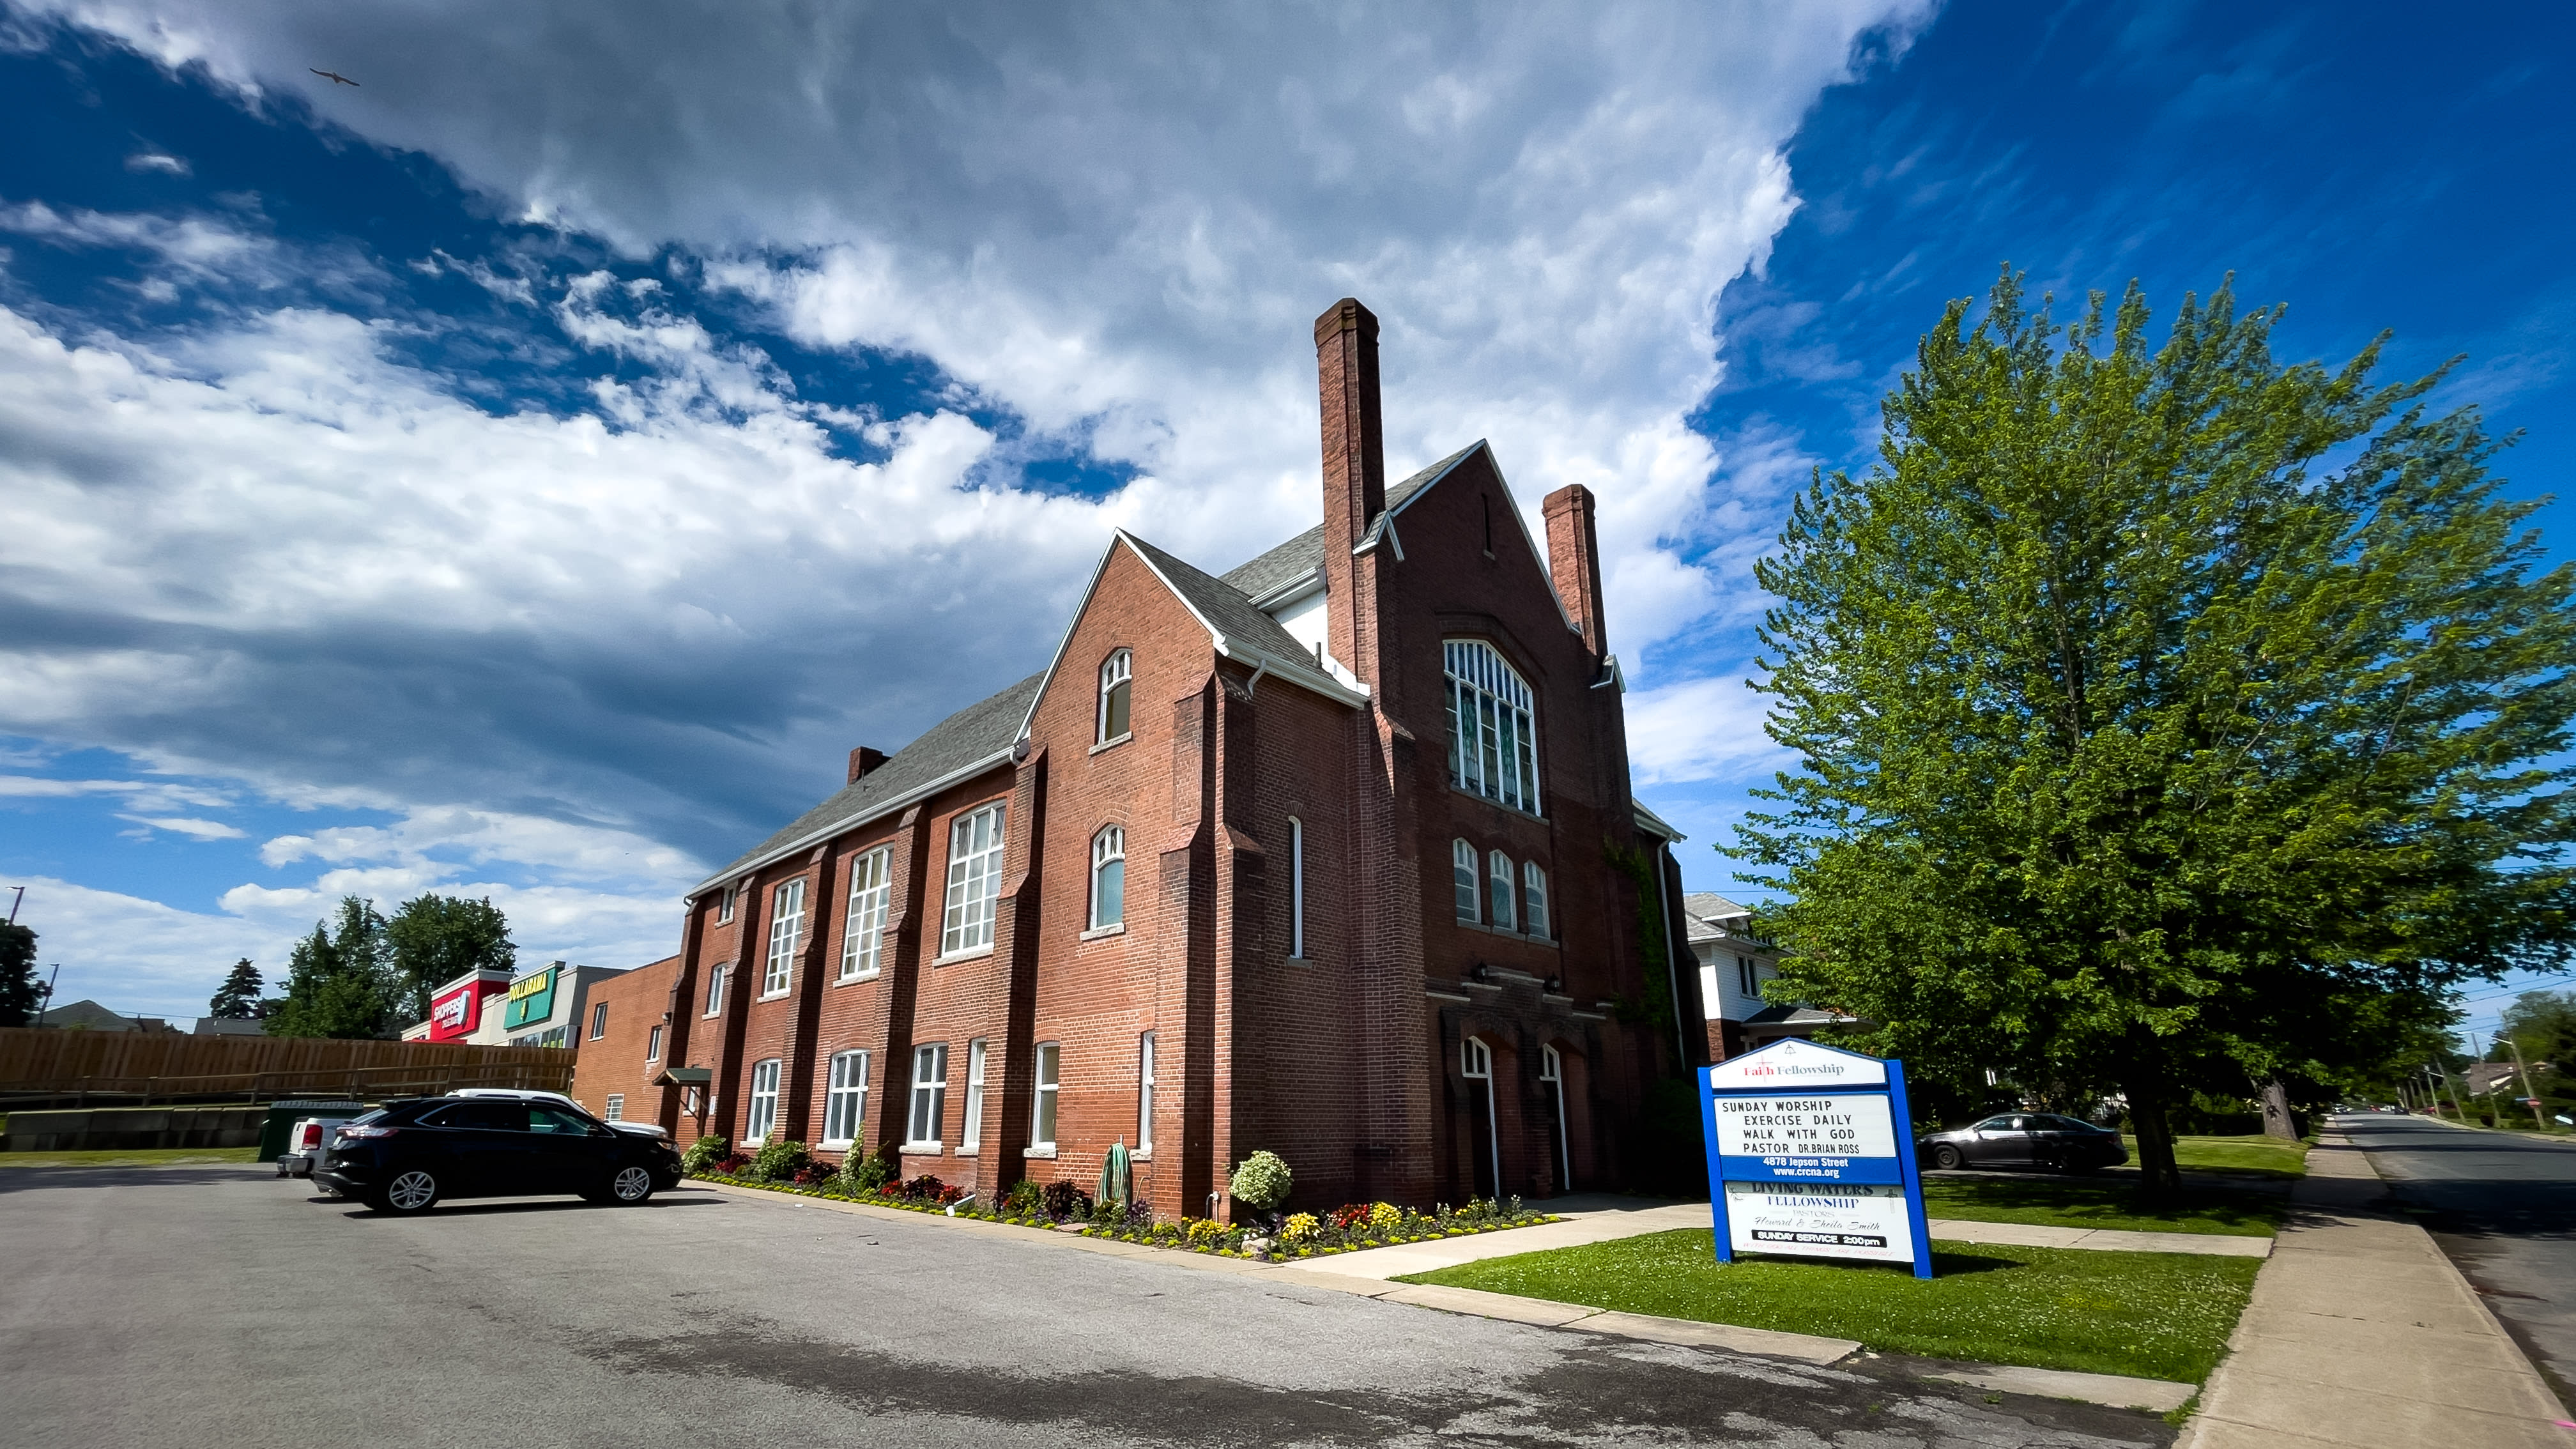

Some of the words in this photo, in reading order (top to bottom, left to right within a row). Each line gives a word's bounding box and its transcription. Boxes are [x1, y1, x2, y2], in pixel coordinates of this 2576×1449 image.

[509, 972, 547, 1002] DOLLARAMA
[434, 996, 461, 1022] SHOPPERS
[1777, 1064, 1844, 1076] Fellowship
[1722, 1101, 1768, 1112] SUNDAY
[1775, 1100, 1832, 1111] WORSHIP
[1744, 1115, 1802, 1126] EXERCISE
[1814, 1114, 1851, 1125] DAILY
[1744, 1129, 1774, 1139] WALK
[1787, 1129, 1817, 1139] WITH
[1830, 1129, 1855, 1139] GOD
[1744, 1143, 1790, 1153] PASTOR
[1838, 1144, 1860, 1154] ROSS
[1763, 1157, 1787, 1167] 4878
[1789, 1157, 1818, 1168] Jepson
[1820, 1158, 1849, 1167] Street
[1773, 1167, 1840, 1179] www.crcna.org
[1752, 1183, 1804, 1194] LIVING
[1809, 1183, 1874, 1196] WATERS
[1768, 1196, 1859, 1208] FELLOWSHIP
[1754, 1216, 1792, 1227] Howard
[1809, 1220, 1843, 1229] Sheila
[1846, 1222, 1880, 1231] Smith
[1758, 1231, 1794, 1241] SUNDAY
[1796, 1233, 1839, 1243] SERVICE
